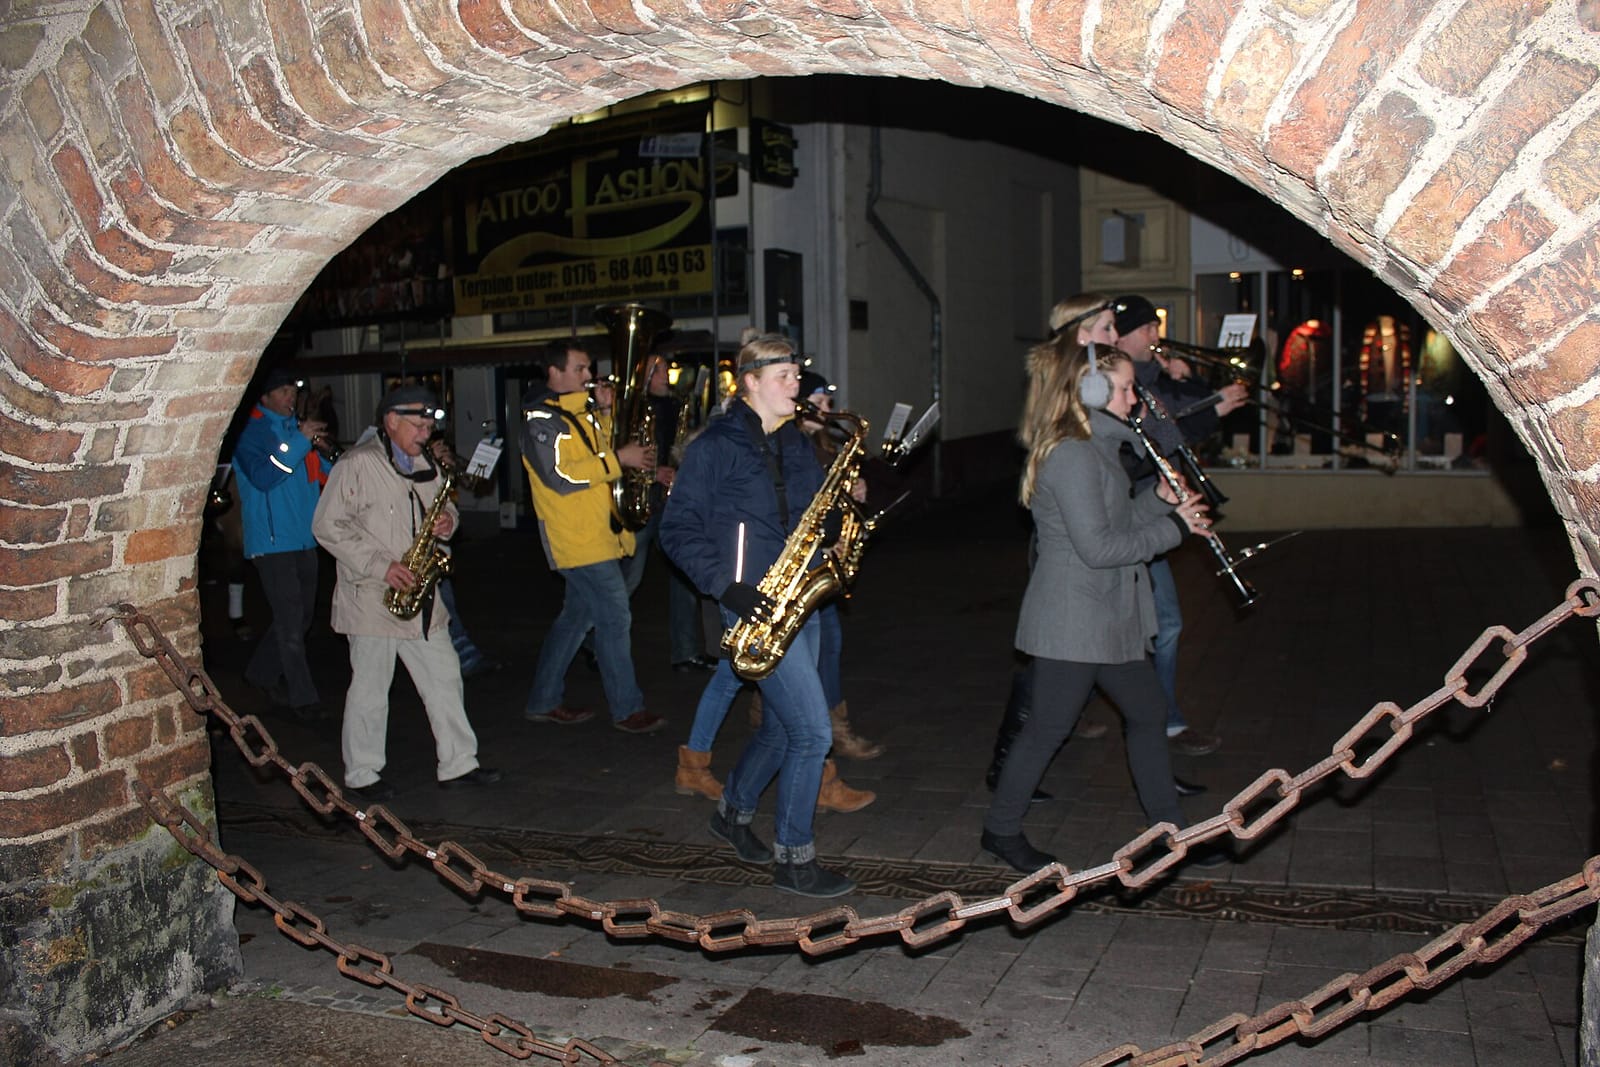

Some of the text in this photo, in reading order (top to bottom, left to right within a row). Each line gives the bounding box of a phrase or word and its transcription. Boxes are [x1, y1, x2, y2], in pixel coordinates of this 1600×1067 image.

[460, 275, 513, 297] Termine
[562, 262, 597, 287] 0176
[609, 258, 630, 281] 68
[633, 255, 653, 278] 40
[657, 252, 679, 275] 49
[683, 249, 705, 273] 63
